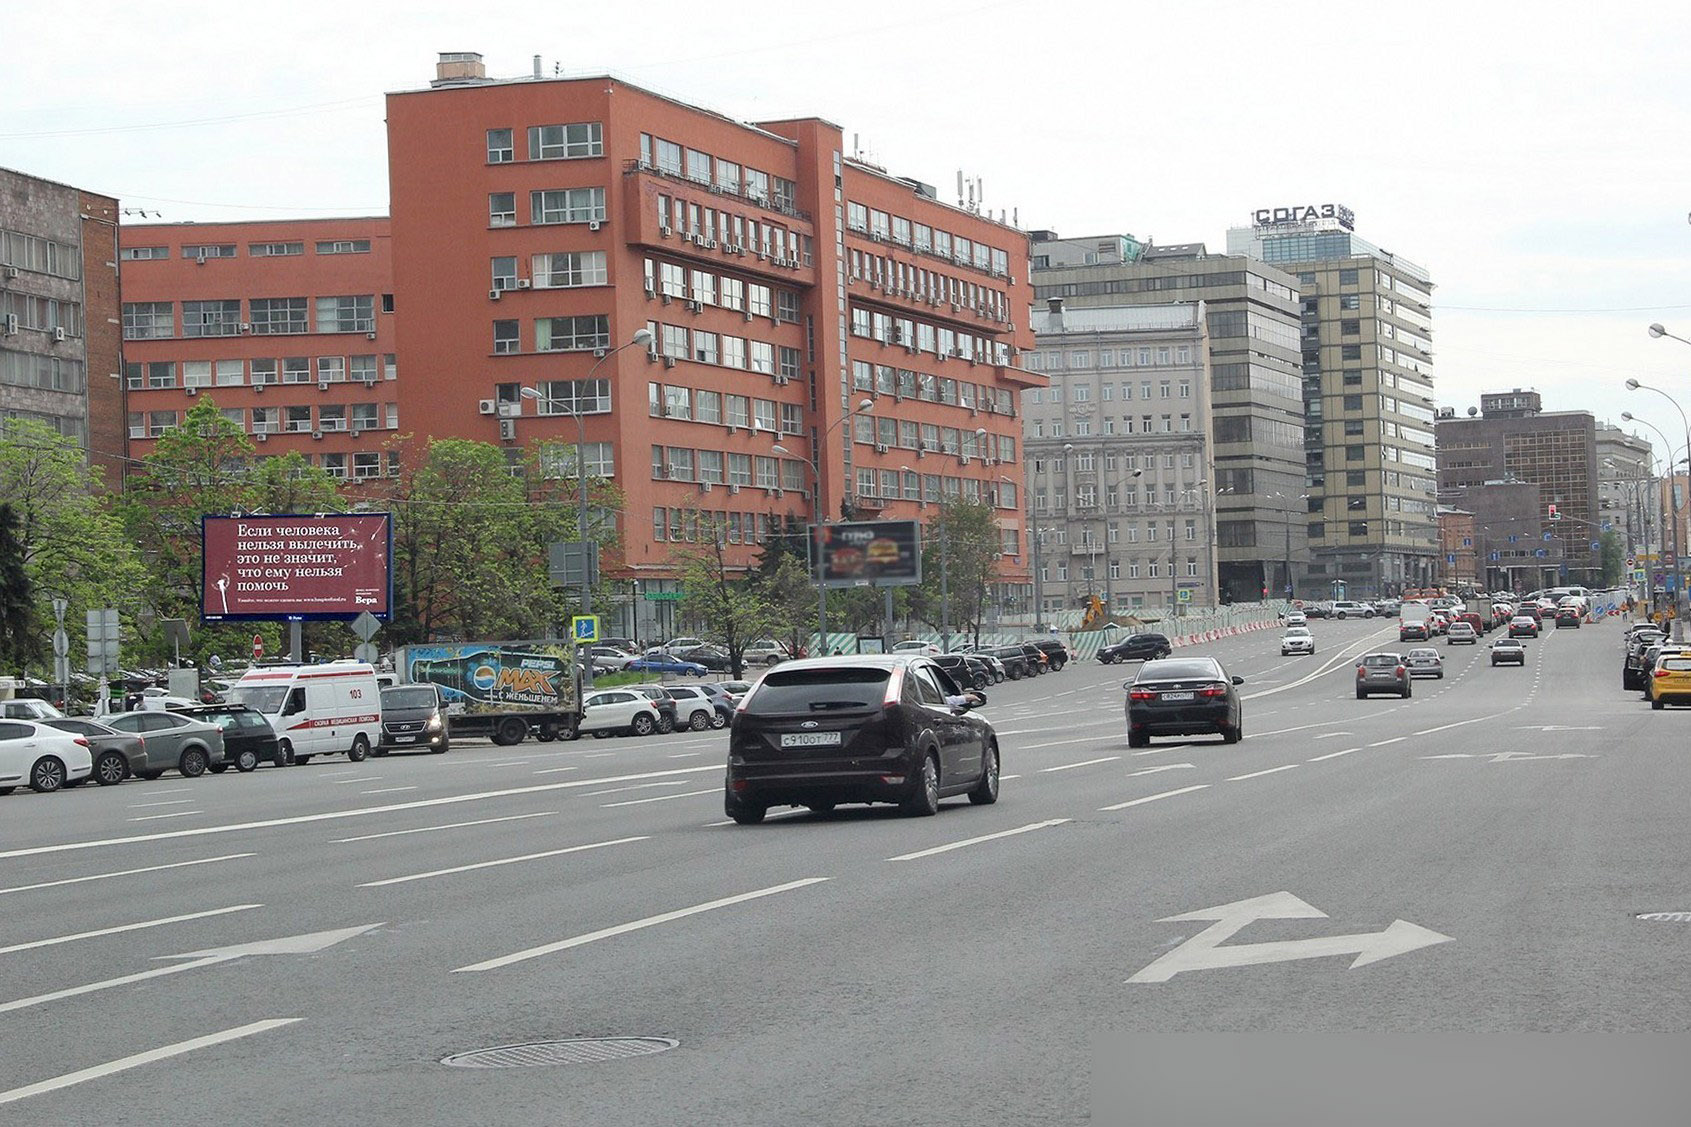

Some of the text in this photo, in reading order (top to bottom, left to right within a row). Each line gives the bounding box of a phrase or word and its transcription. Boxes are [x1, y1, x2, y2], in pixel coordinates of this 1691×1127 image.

[1256, 204, 1335, 224] СОГАЗ
[237, 524, 340, 537] Если человека
[237, 539, 361, 551] нельзя вылечить,
[237, 553, 337, 564] это не значит,
[237, 567, 343, 579] что ему нельзя
[237, 581, 289, 592] помочь
[355, 596, 378, 605] Вера
[521, 659, 555, 669] PEPSI
[494, 666, 561, 696] MAX
[350, 689, 362, 699] 103
